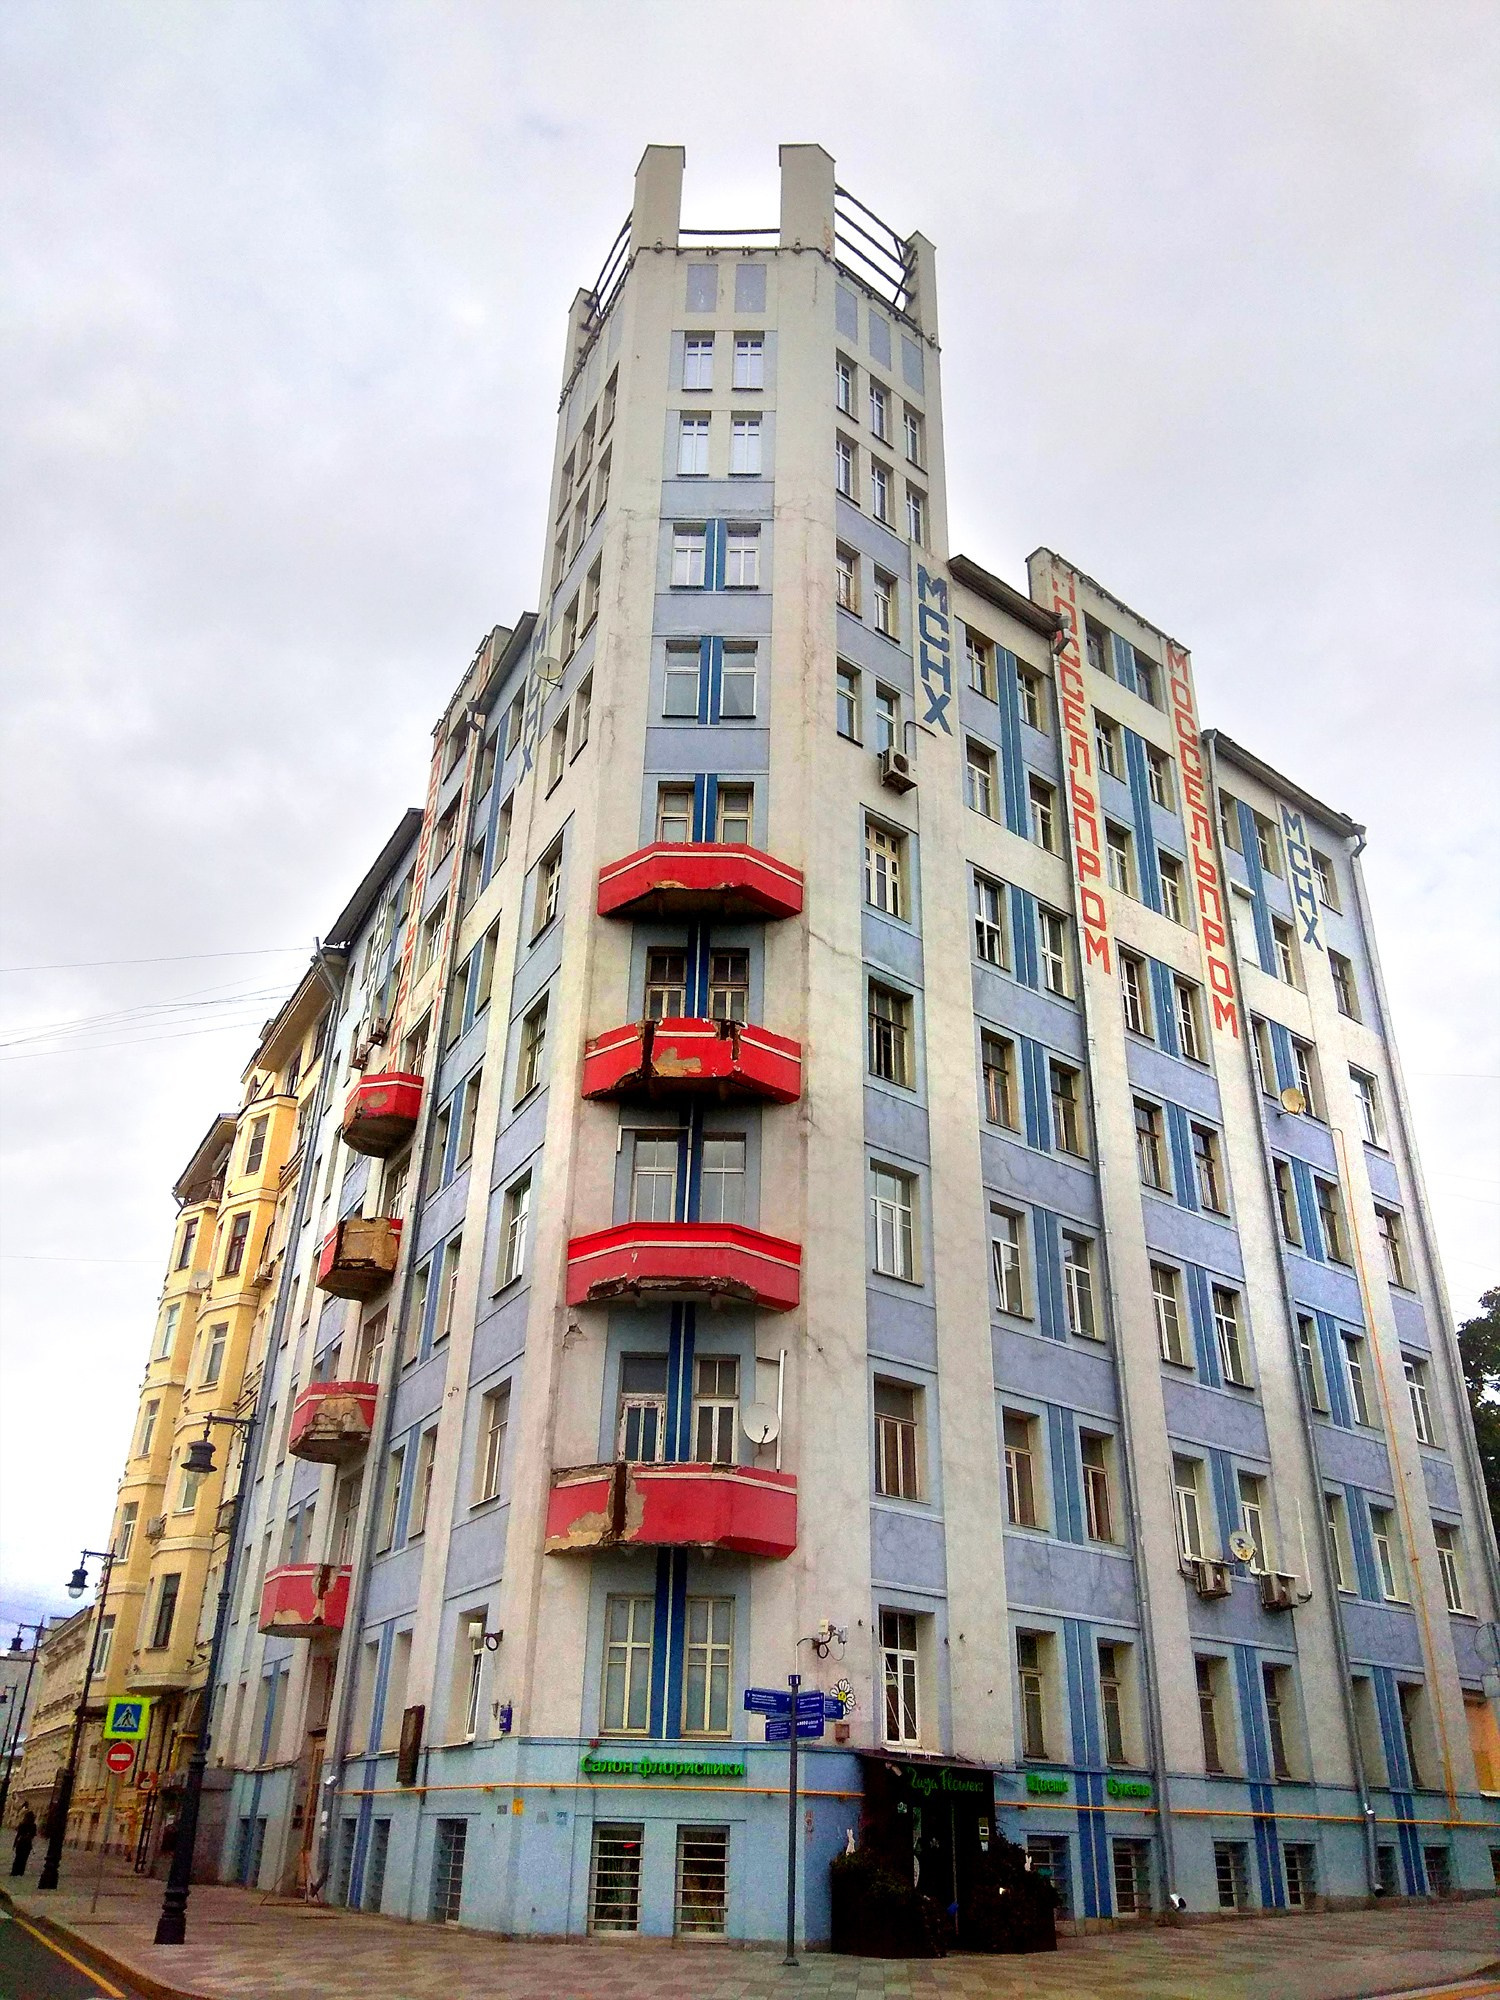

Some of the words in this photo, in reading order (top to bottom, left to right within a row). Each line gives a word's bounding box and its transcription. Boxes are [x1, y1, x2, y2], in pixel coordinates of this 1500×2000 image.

[916, 563, 952, 736] МСНХ
[1166, 637, 1239, 1039] МОССЕЛЬПРОМ
[1280, 804, 1323, 951] МСНХ
[580, 1755, 633, 1773] Салон
[638, 1756, 745, 1779] флористики
